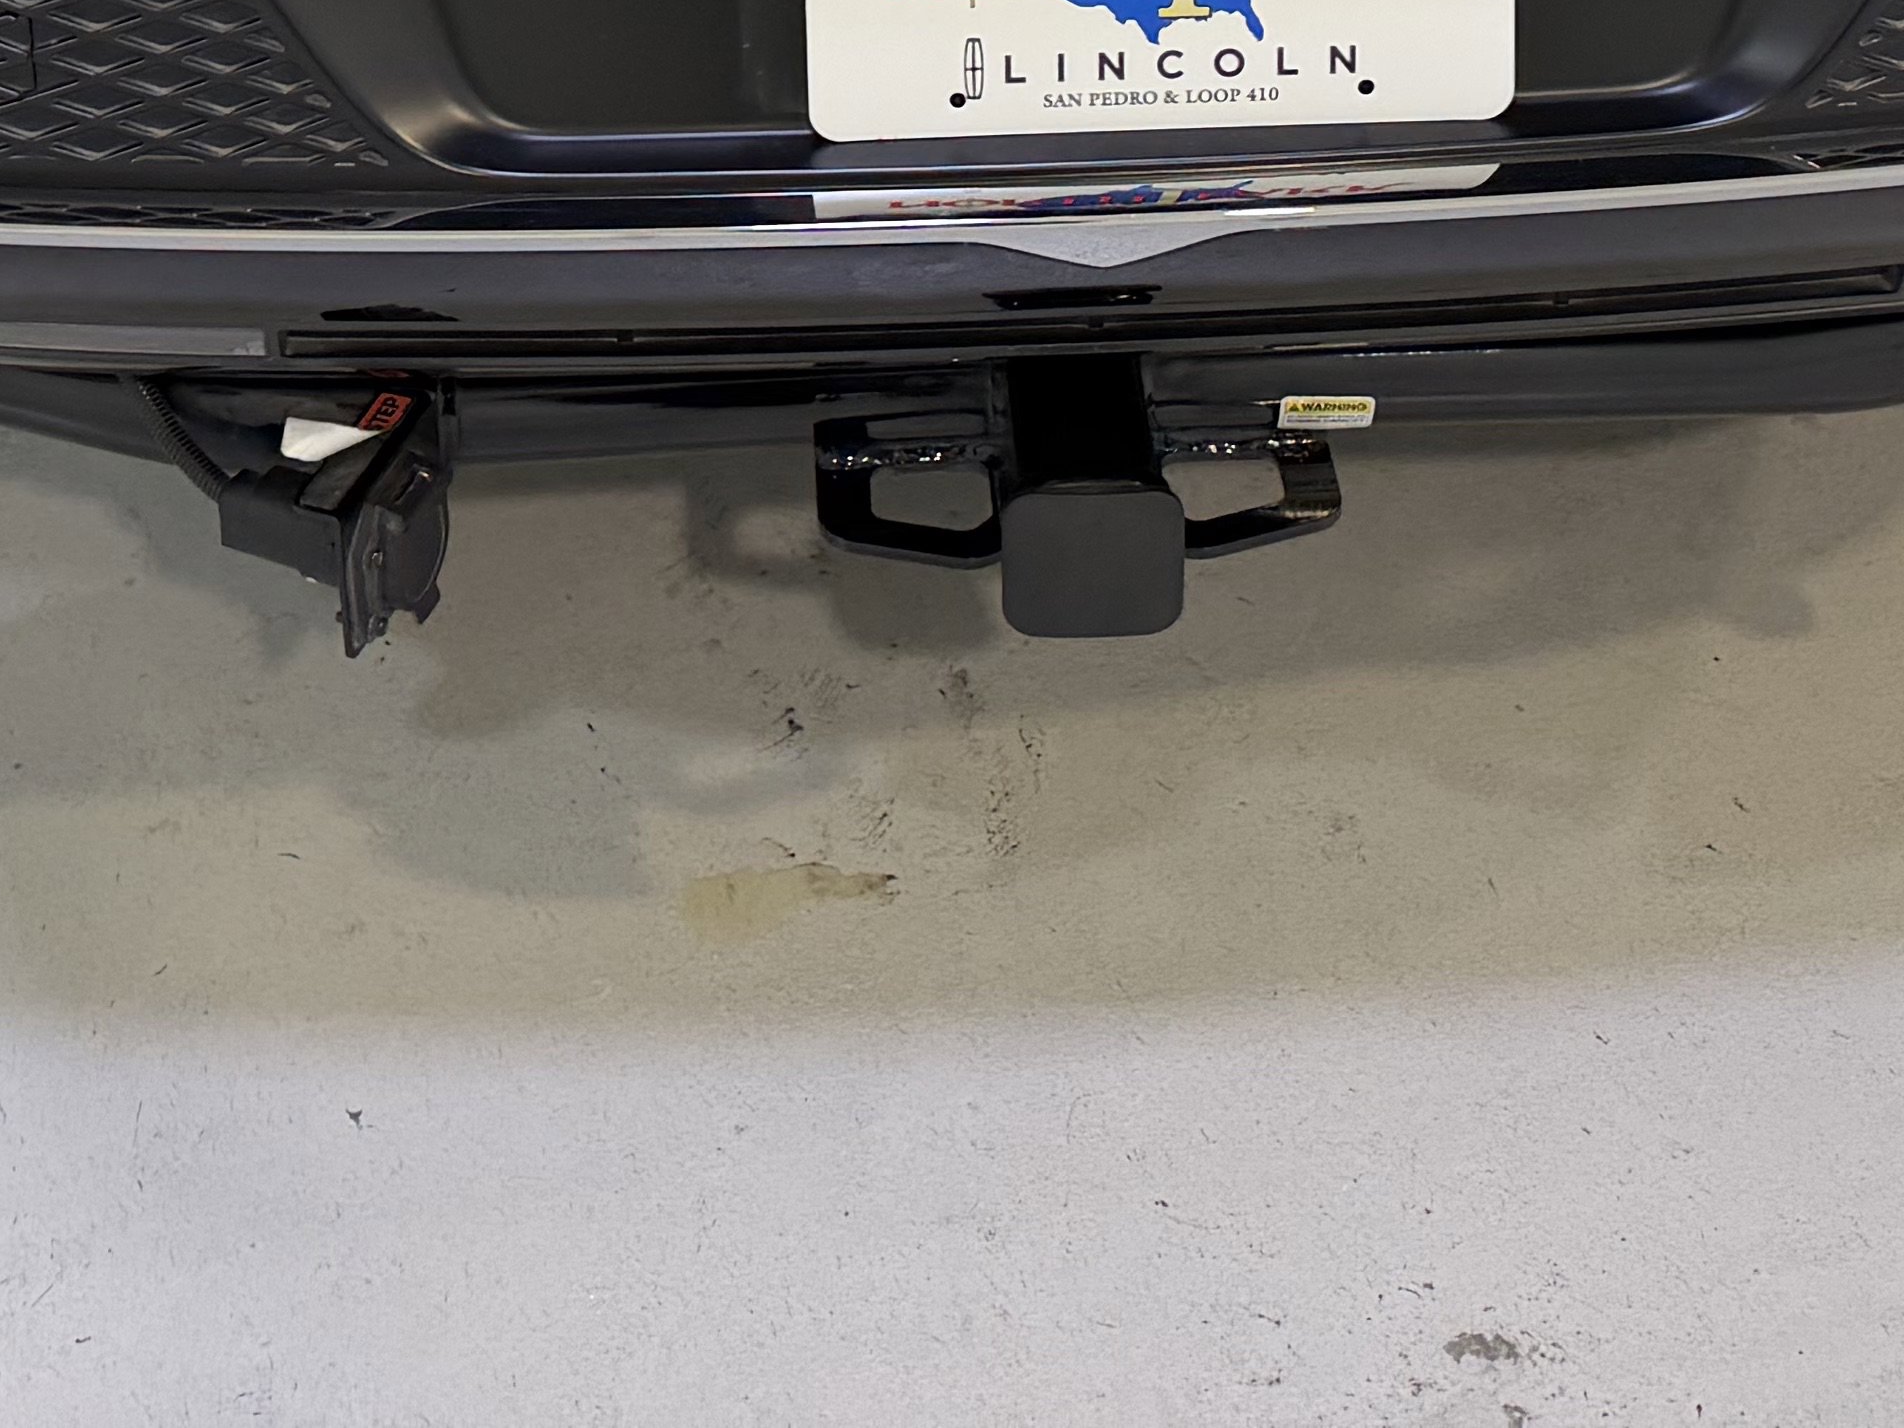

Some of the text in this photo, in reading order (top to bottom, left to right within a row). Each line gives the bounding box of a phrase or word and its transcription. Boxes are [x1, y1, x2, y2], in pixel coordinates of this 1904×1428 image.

[1003, 45, 1358, 85] LINCOLN
[1042, 86, 1280, 109] SAN PEDRO & LOOP 410
